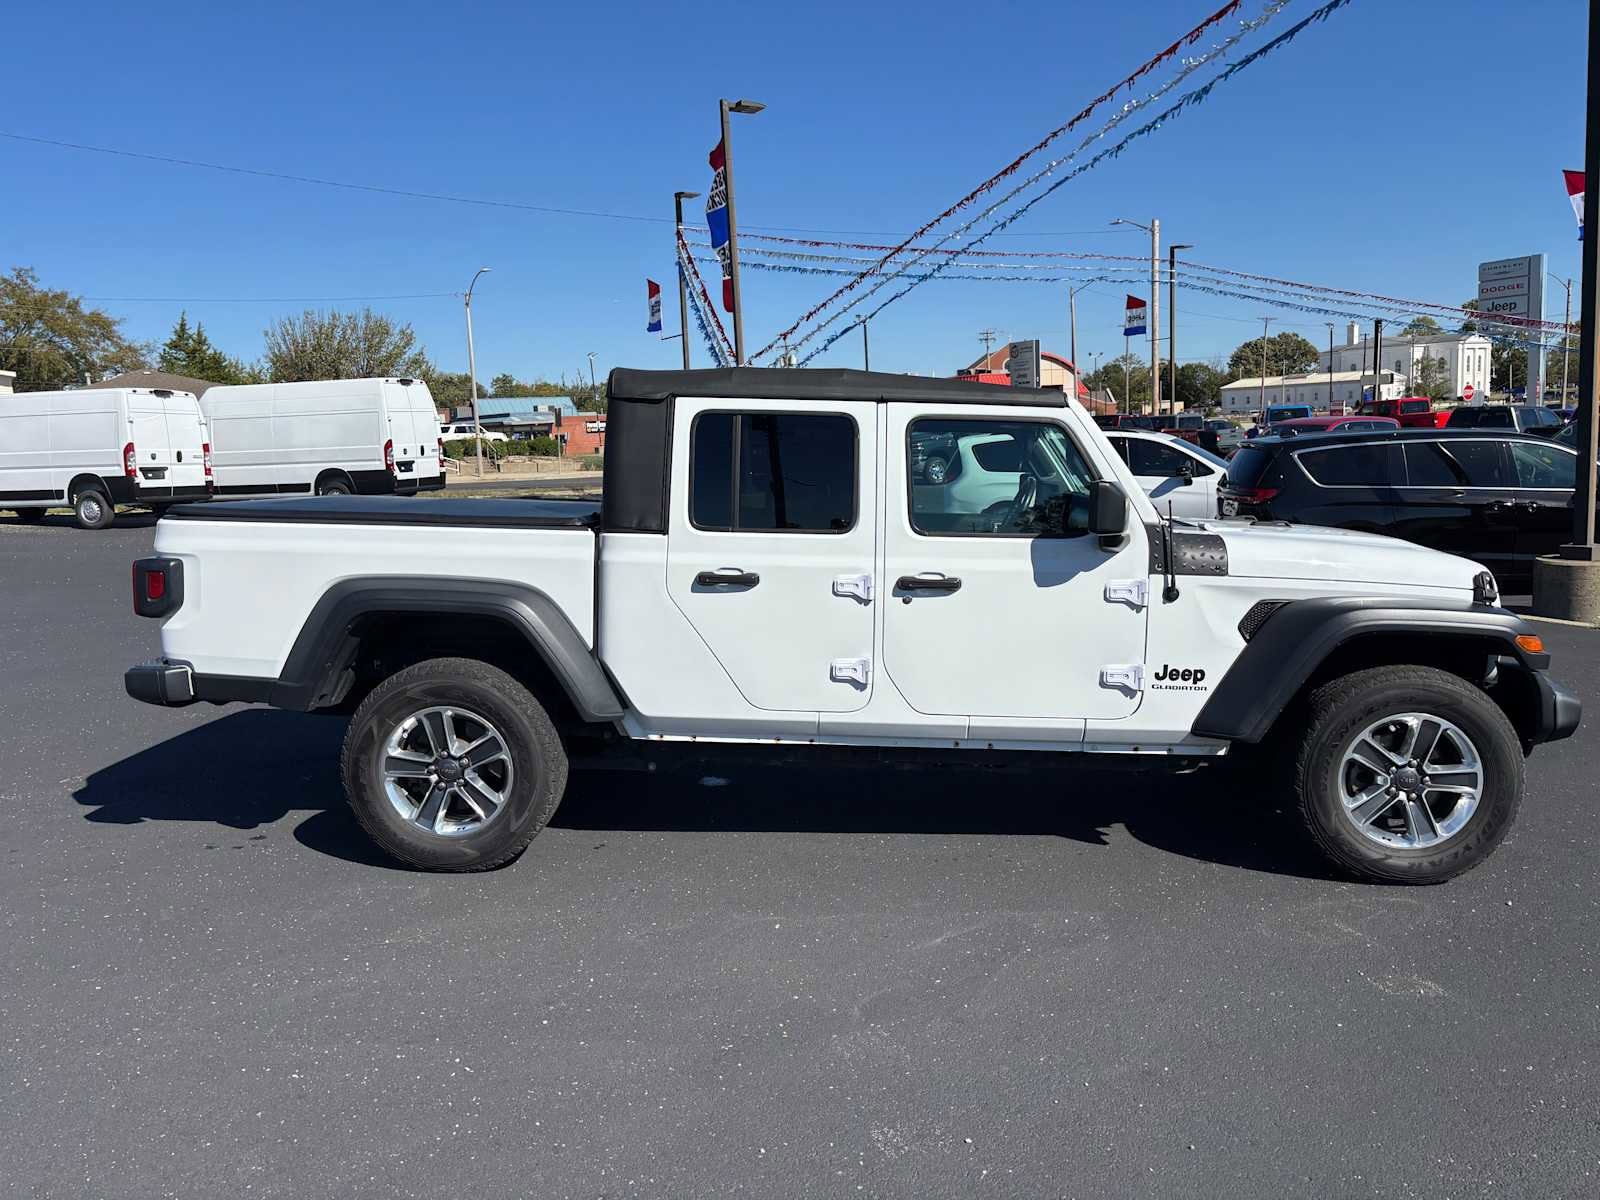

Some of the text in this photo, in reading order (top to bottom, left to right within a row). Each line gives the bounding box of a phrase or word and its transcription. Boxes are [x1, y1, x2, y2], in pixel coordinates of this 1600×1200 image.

[1481, 284, 1525, 294] DODGE
[1487, 301, 1517, 313] Jeep
[1154, 664, 1206, 685] Jeep
